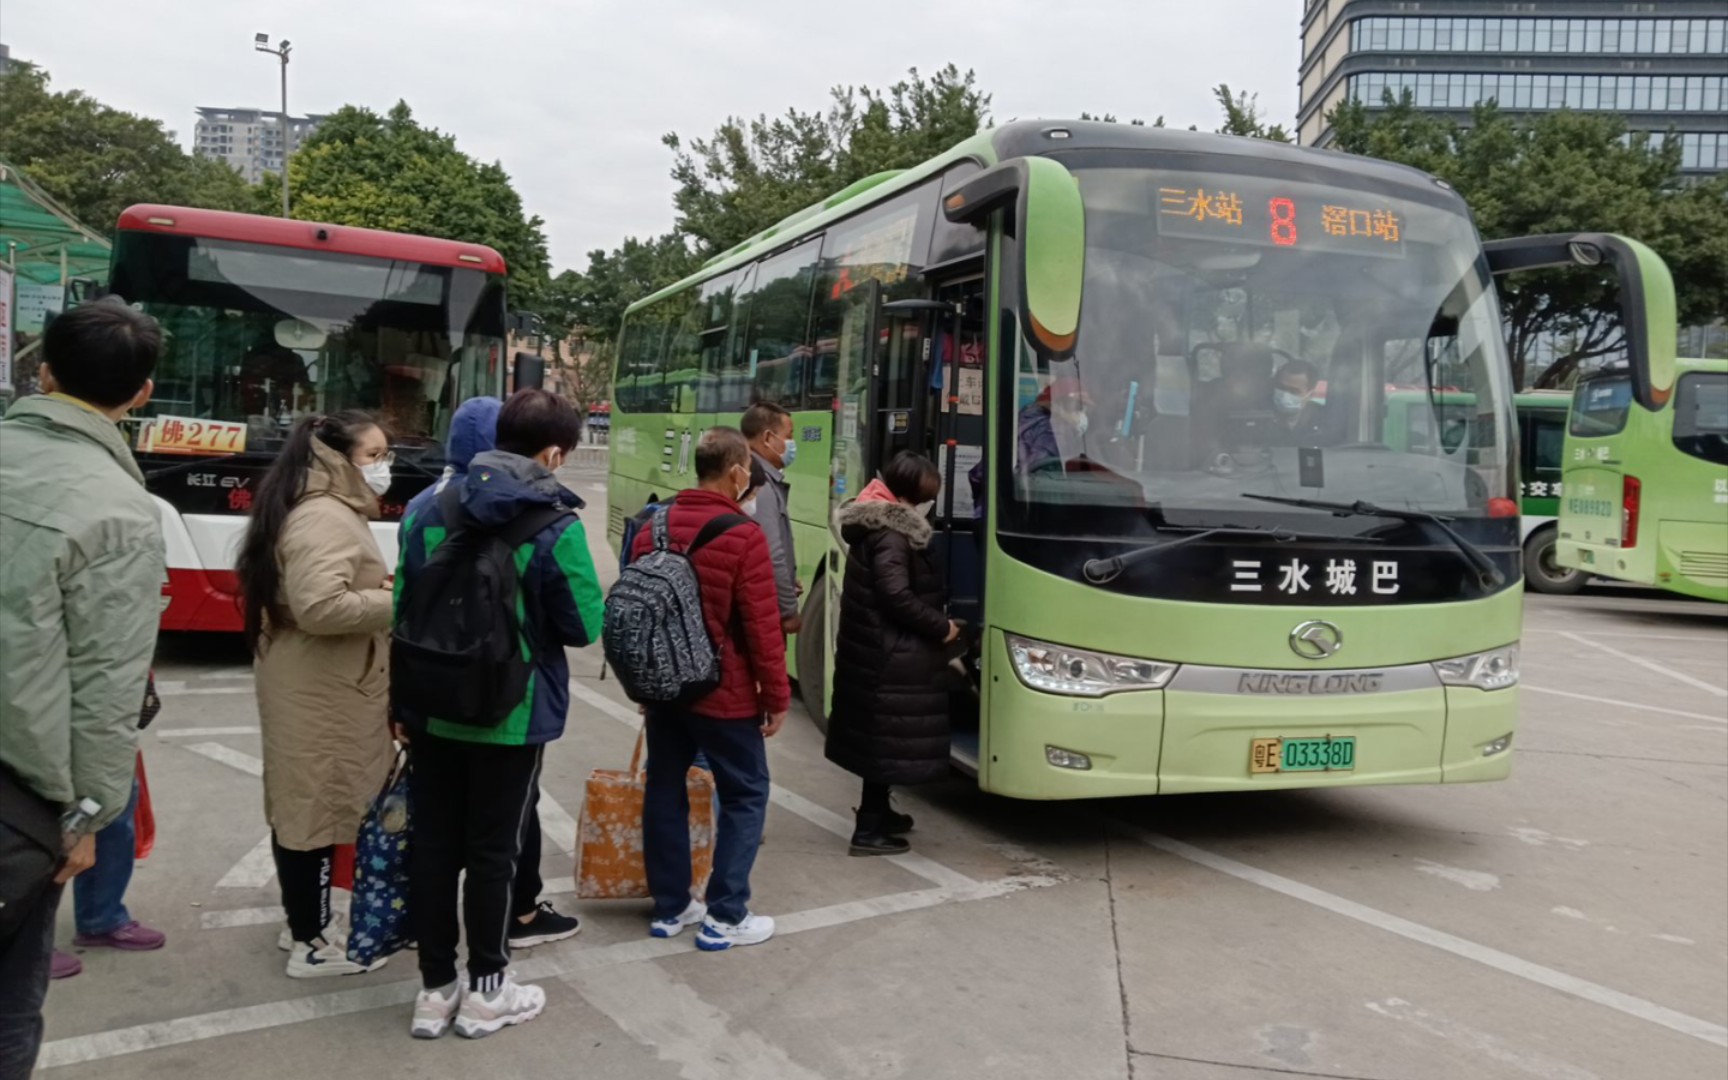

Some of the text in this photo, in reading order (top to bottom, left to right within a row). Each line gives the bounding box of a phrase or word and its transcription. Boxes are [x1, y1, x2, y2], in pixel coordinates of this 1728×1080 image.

[1159, 187, 1243, 224] 三水站
[1269, 196, 1297, 246] 8
[161, 418, 241, 449] 佛277
[187, 472, 250, 488] 长江 EV
[1230, 558, 1400, 595] 三水城巴
